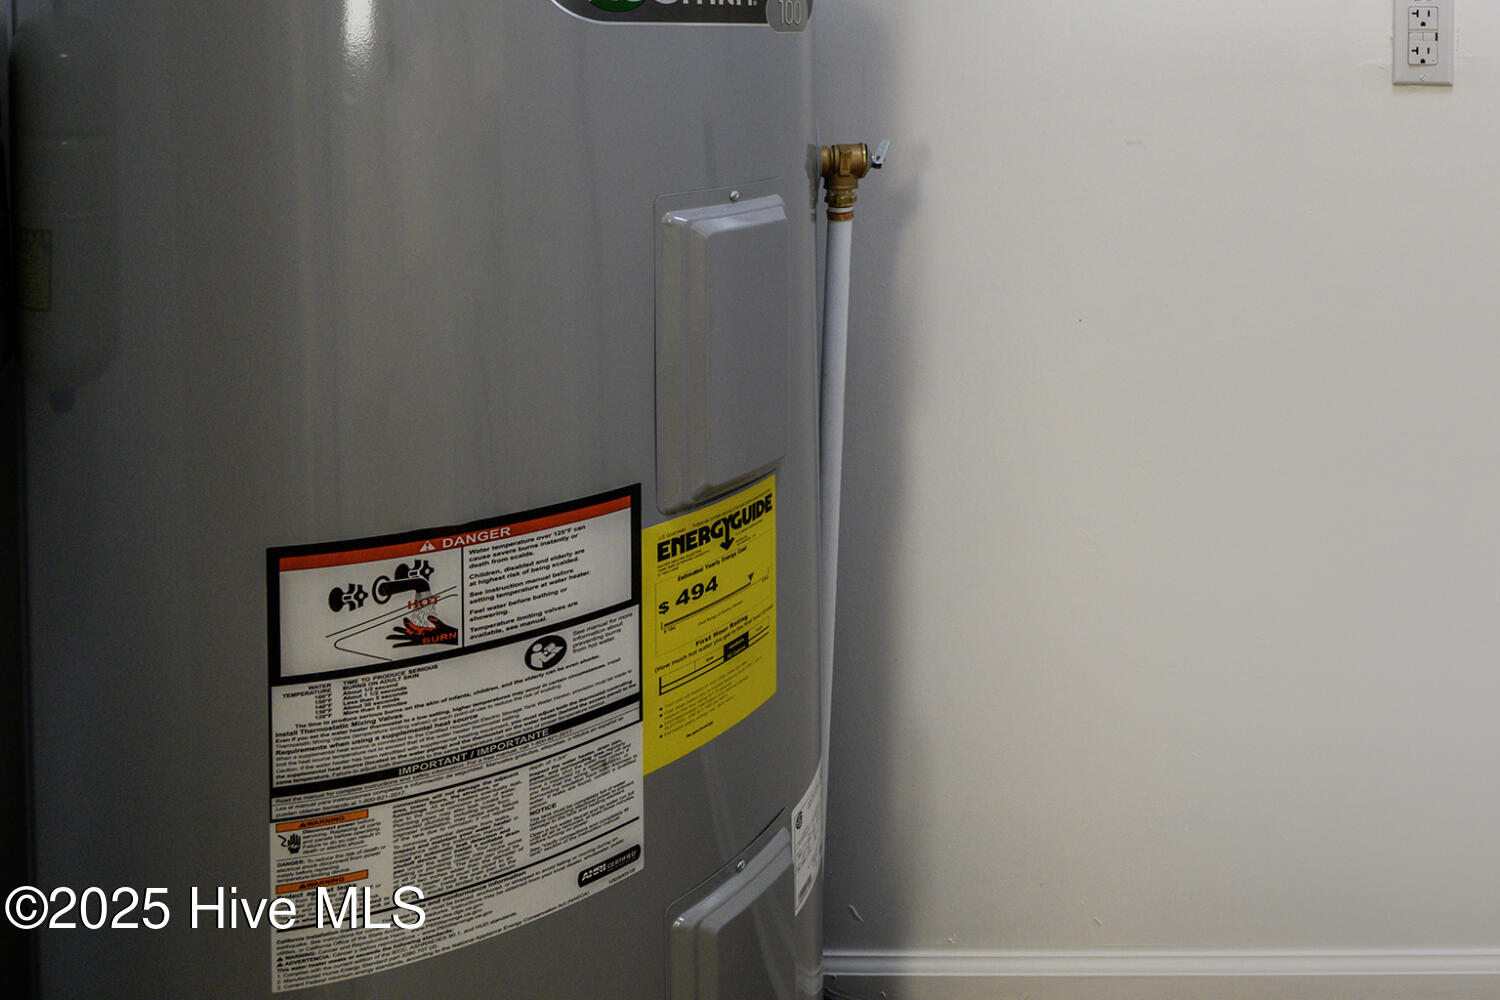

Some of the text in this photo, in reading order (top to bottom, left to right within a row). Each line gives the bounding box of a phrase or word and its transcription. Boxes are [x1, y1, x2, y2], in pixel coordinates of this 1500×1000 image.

[777, 0, 801, 25] 100
[657, 493, 773, 562] ENERGYGUIDE
[442, 527, 511, 548] DANGER
[469, 547, 490, 555] Water
[491, 538, 535, 550] temperature
[469, 554, 491, 562] cause
[493, 549, 516, 558] severe
[518, 543, 538, 552] burns
[540, 536, 569, 547] instantly
[469, 560, 490, 569] death
[491, 556, 509, 565] from
[469, 569, 503, 580] Children,
[504, 561, 534, 572] disabled
[536, 557, 549, 565] and
[550, 552, 573, 562] elderly
[478, 575, 505, 586] highest
[507, 571, 520, 579] risk
[531, 565, 551, 574] being
[485, 582, 524, 594] instruction
[525, 574, 551, 585] manual
[552, 569, 574, 578] before
[469, 595, 494, 605] setting
[496, 585, 539, 599] temperature
[549, 577, 567, 586] water
[658, 576, 718, 614] $ 494
[407, 595, 441, 609] HOT
[487, 603, 506, 611] water
[508, 597, 531, 607] before
[532, 589, 559, 600] bathing
[470, 619, 515, 632] Temperature
[516, 610, 543, 621] limiting
[544, 605, 566, 614] valves
[422, 631, 457, 645] BURN
[470, 628, 504, 640] available,
[695, 615, 748, 647] First Hour Rating
[373, 671, 407, 681] PRODUCE
[408, 664, 438, 675] SERIOUS
[308, 683, 331, 691] WATER
[343, 683, 366, 691] BURNS
[379, 676, 402, 684] ADULT
[375, 682, 398, 690] second
[380, 686, 407, 695] seconds
[283, 688, 331, 698] TEMPERATURE
[373, 697, 400, 706] seconds
[381, 691, 408, 699] seconds
[382, 701, 407, 709] minutes
[300, 723, 349, 735] Thermostatic
[351, 718, 376, 728] Mixing
[378, 713, 403, 722] Valves
[331, 716, 357, 725] produce
[359, 712, 383, 720] serious
[275, 744, 328, 756] Requirements
[329, 740, 350, 749] when
[351, 737, 373, 746] using
[382, 724, 433, 740] supplemental
[434, 720, 451, 729] heat
[452, 714, 478, 724] source
[398, 752, 467, 776] IMPORTANT
[477, 728, 550, 757] IMPORTANTE
[530, 803, 557, 816] NOTICE
[306, 816, 345, 827] WARNING
[306, 876, 345, 887] WARNING
